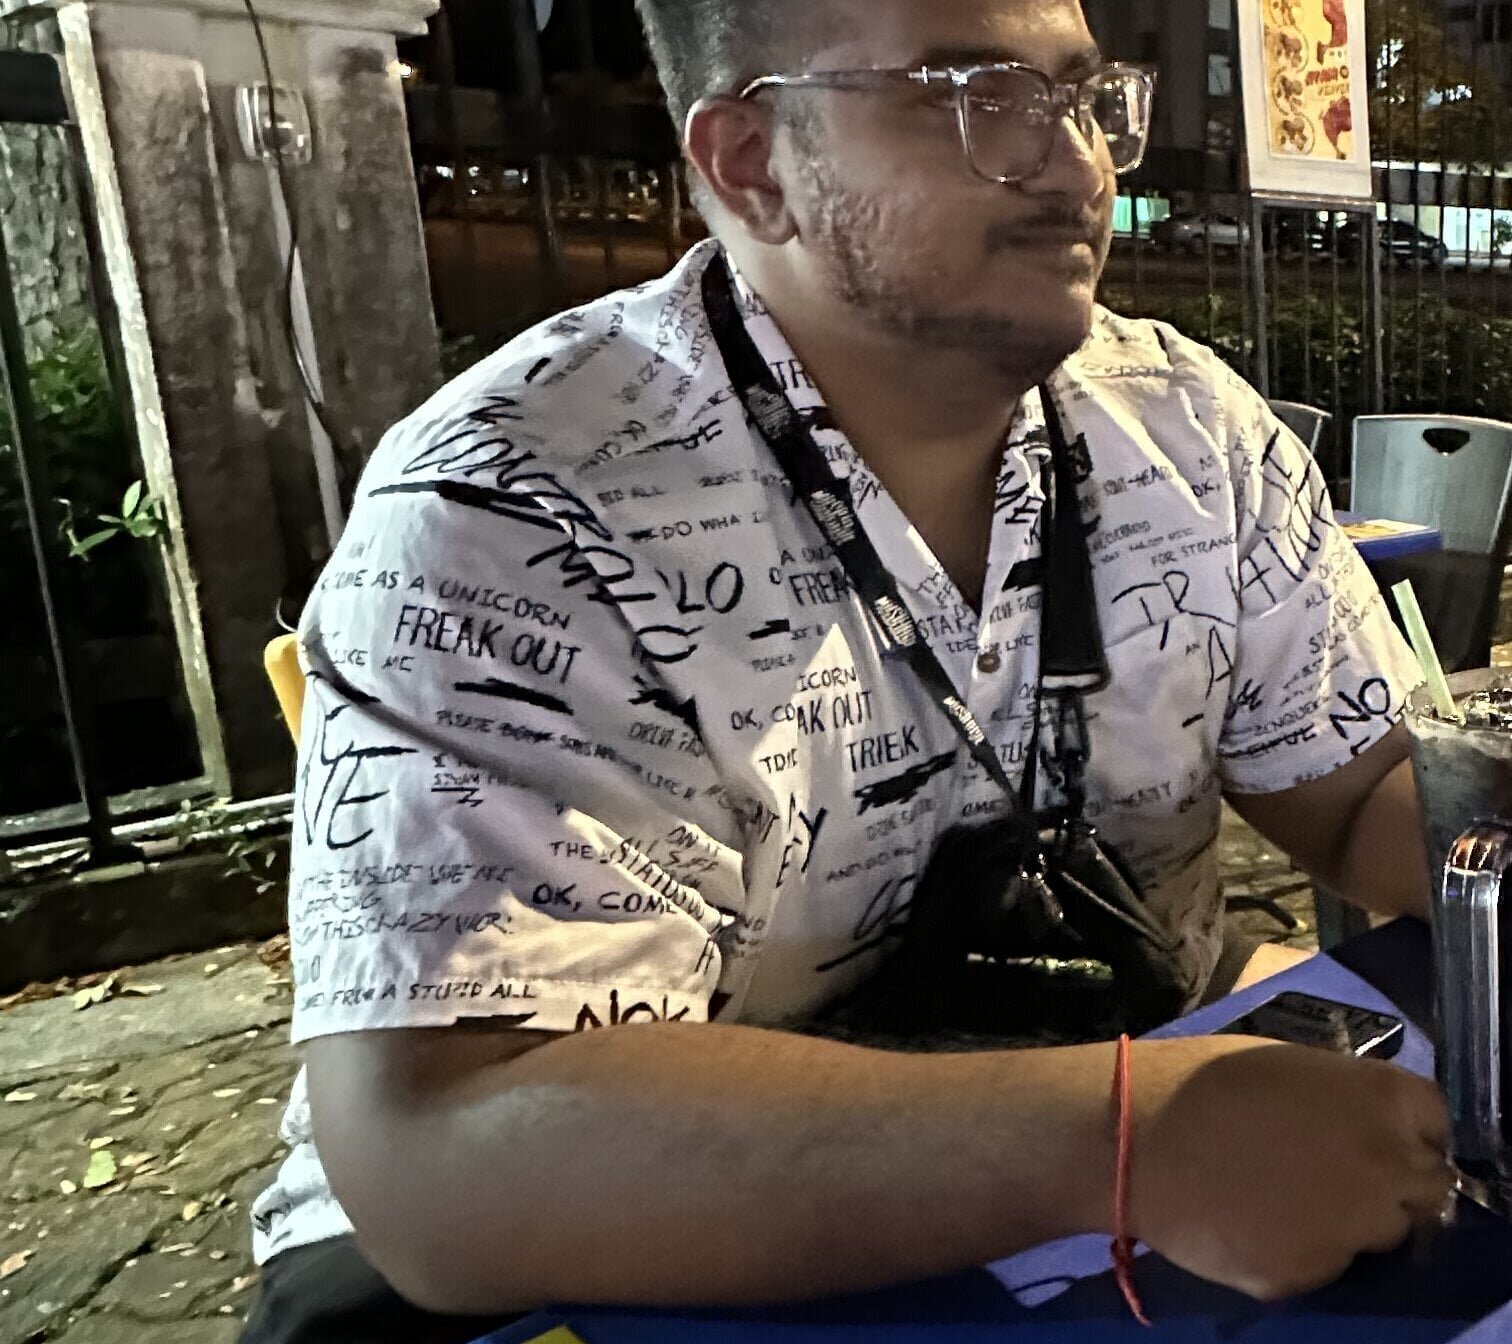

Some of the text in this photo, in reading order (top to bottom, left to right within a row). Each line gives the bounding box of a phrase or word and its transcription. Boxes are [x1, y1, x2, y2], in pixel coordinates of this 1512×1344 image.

[438, 579, 573, 631] UNICORN
[393, 603, 584, 685] FREAK OUT
[550, 840, 594, 860] THE
[533, 882, 583, 912] OK,
